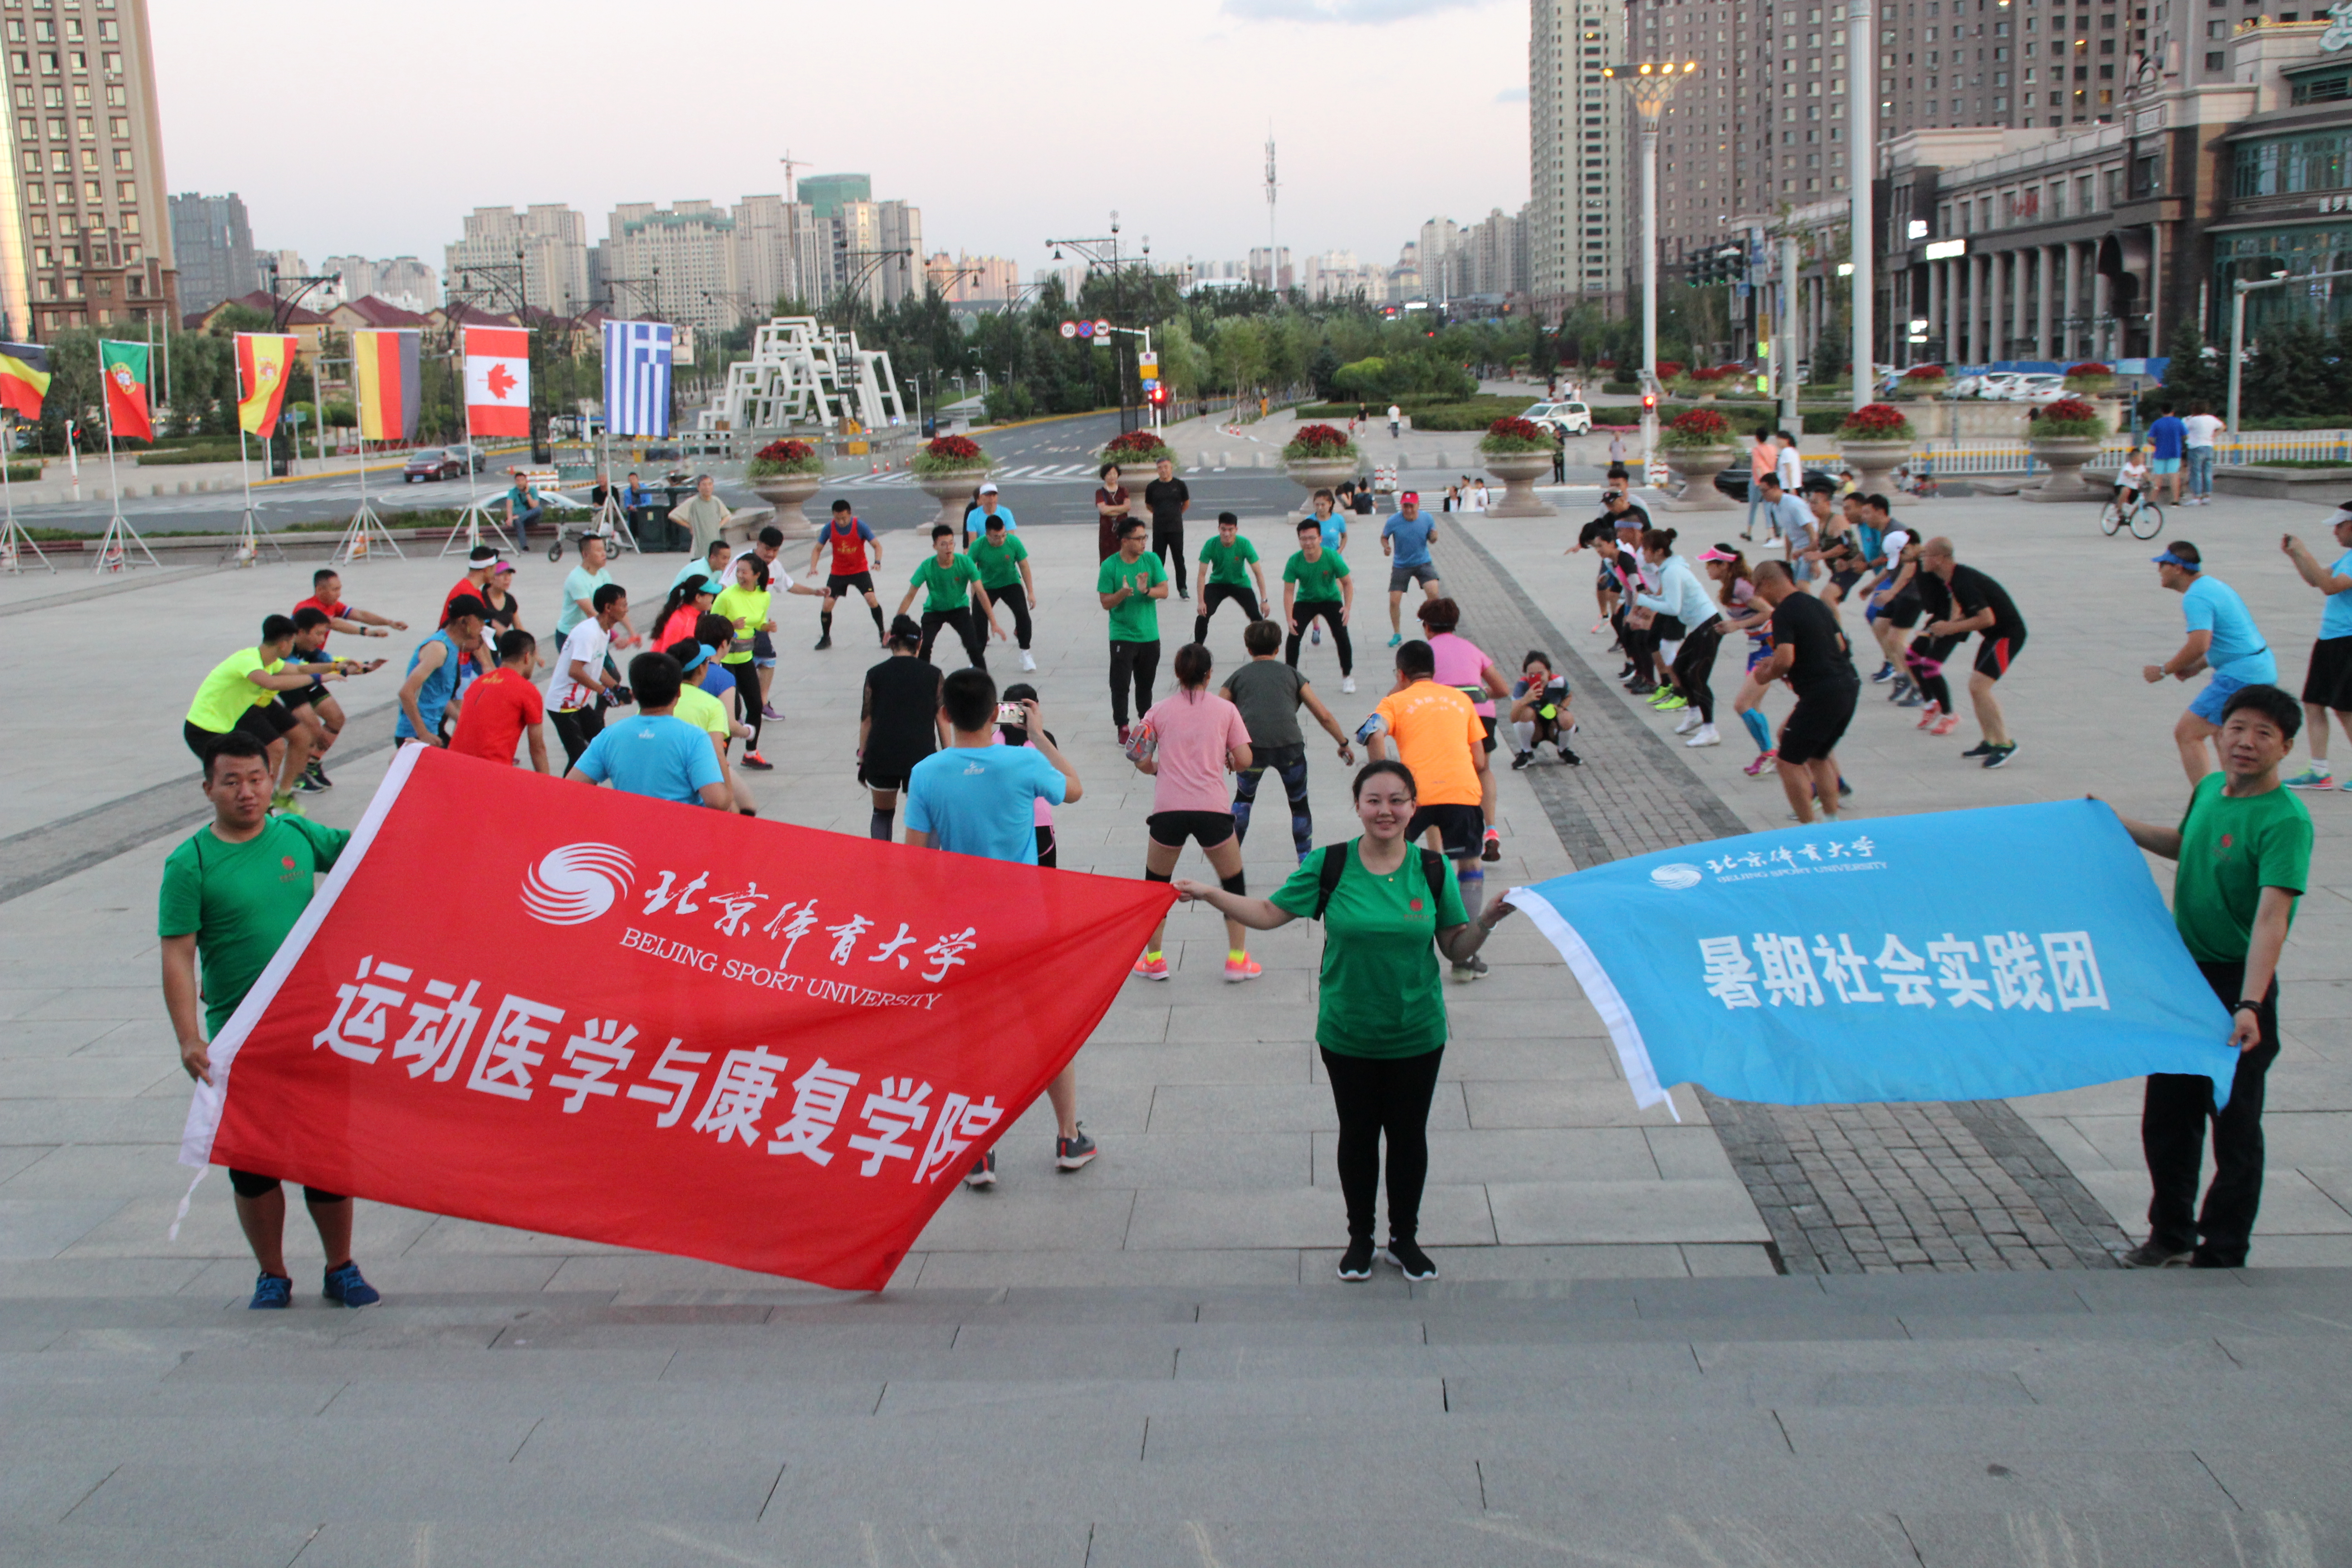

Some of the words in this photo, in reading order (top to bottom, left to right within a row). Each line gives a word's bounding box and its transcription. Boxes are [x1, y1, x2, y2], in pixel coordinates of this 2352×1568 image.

[1063, 325, 1074, 334] 50
[1706, 836, 1875, 874] 北京体育大学
[1717, 870, 1768, 882] BEIJING
[1770, 867, 1810, 877] SPORT
[1814, 861, 1887, 873] UNIVERSITY
[643, 871, 976, 982] 北京体育大学
[620, 927, 717, 972] BEIJING
[722, 960, 803, 991] SPORT
[807, 979, 942, 1009] UNIVERSITY
[1699, 931, 2110, 1012] 暑期社会实践团
[314, 956, 1004, 1183] 运动医学与康复学院
